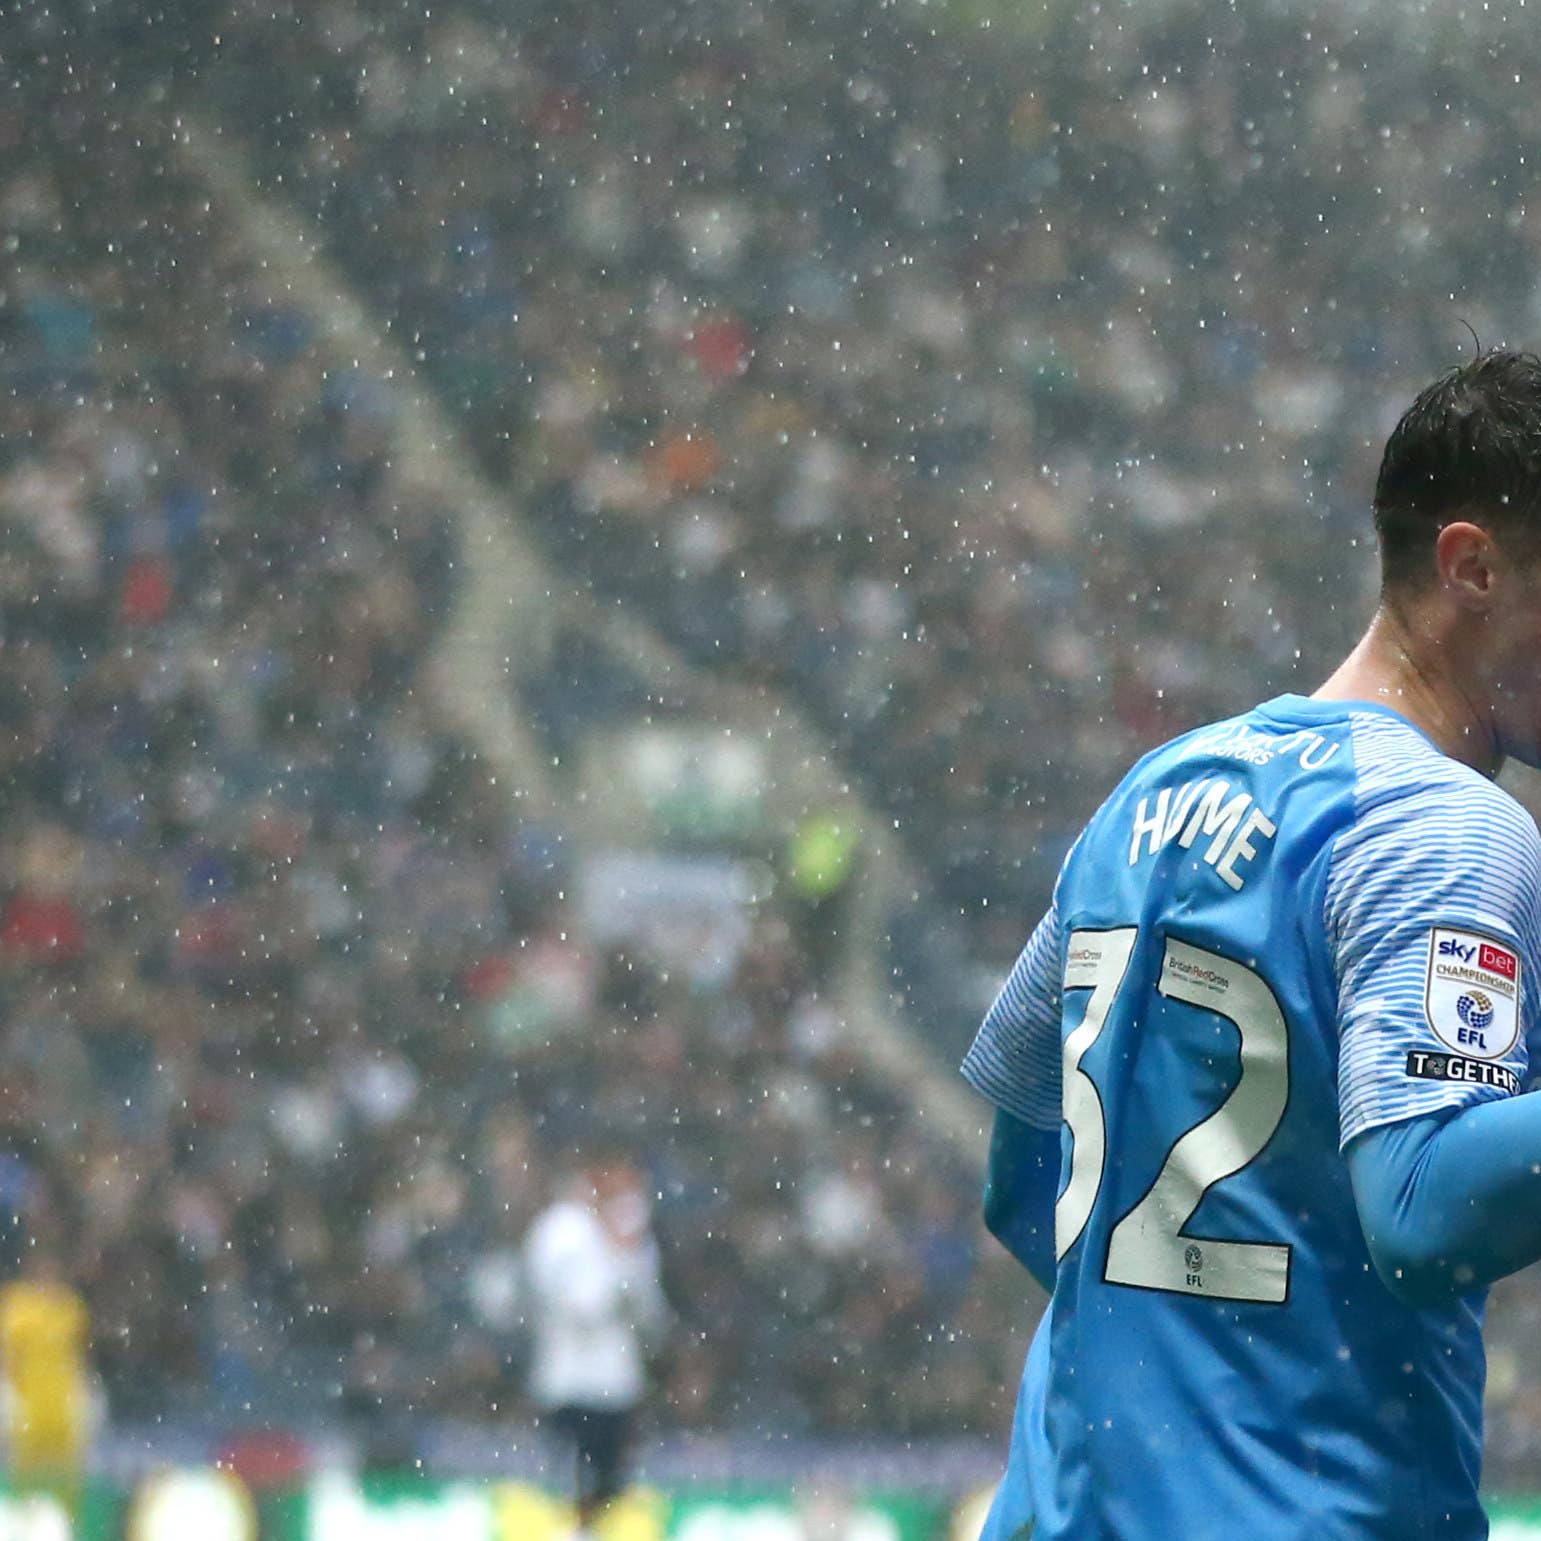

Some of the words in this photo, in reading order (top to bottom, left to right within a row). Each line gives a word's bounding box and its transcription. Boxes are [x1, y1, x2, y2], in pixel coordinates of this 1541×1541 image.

[1128, 780, 1277, 892] HUME
[1438, 938, 1477, 962] sky
[1483, 951, 1513, 974] bet
[1436, 964, 1516, 994] CHAMPIONSHIP
[1457, 1028, 1487, 1050] EFL
[1055, 926, 1293, 1302] 32
[1186, 1273, 1202, 1288] EFL
